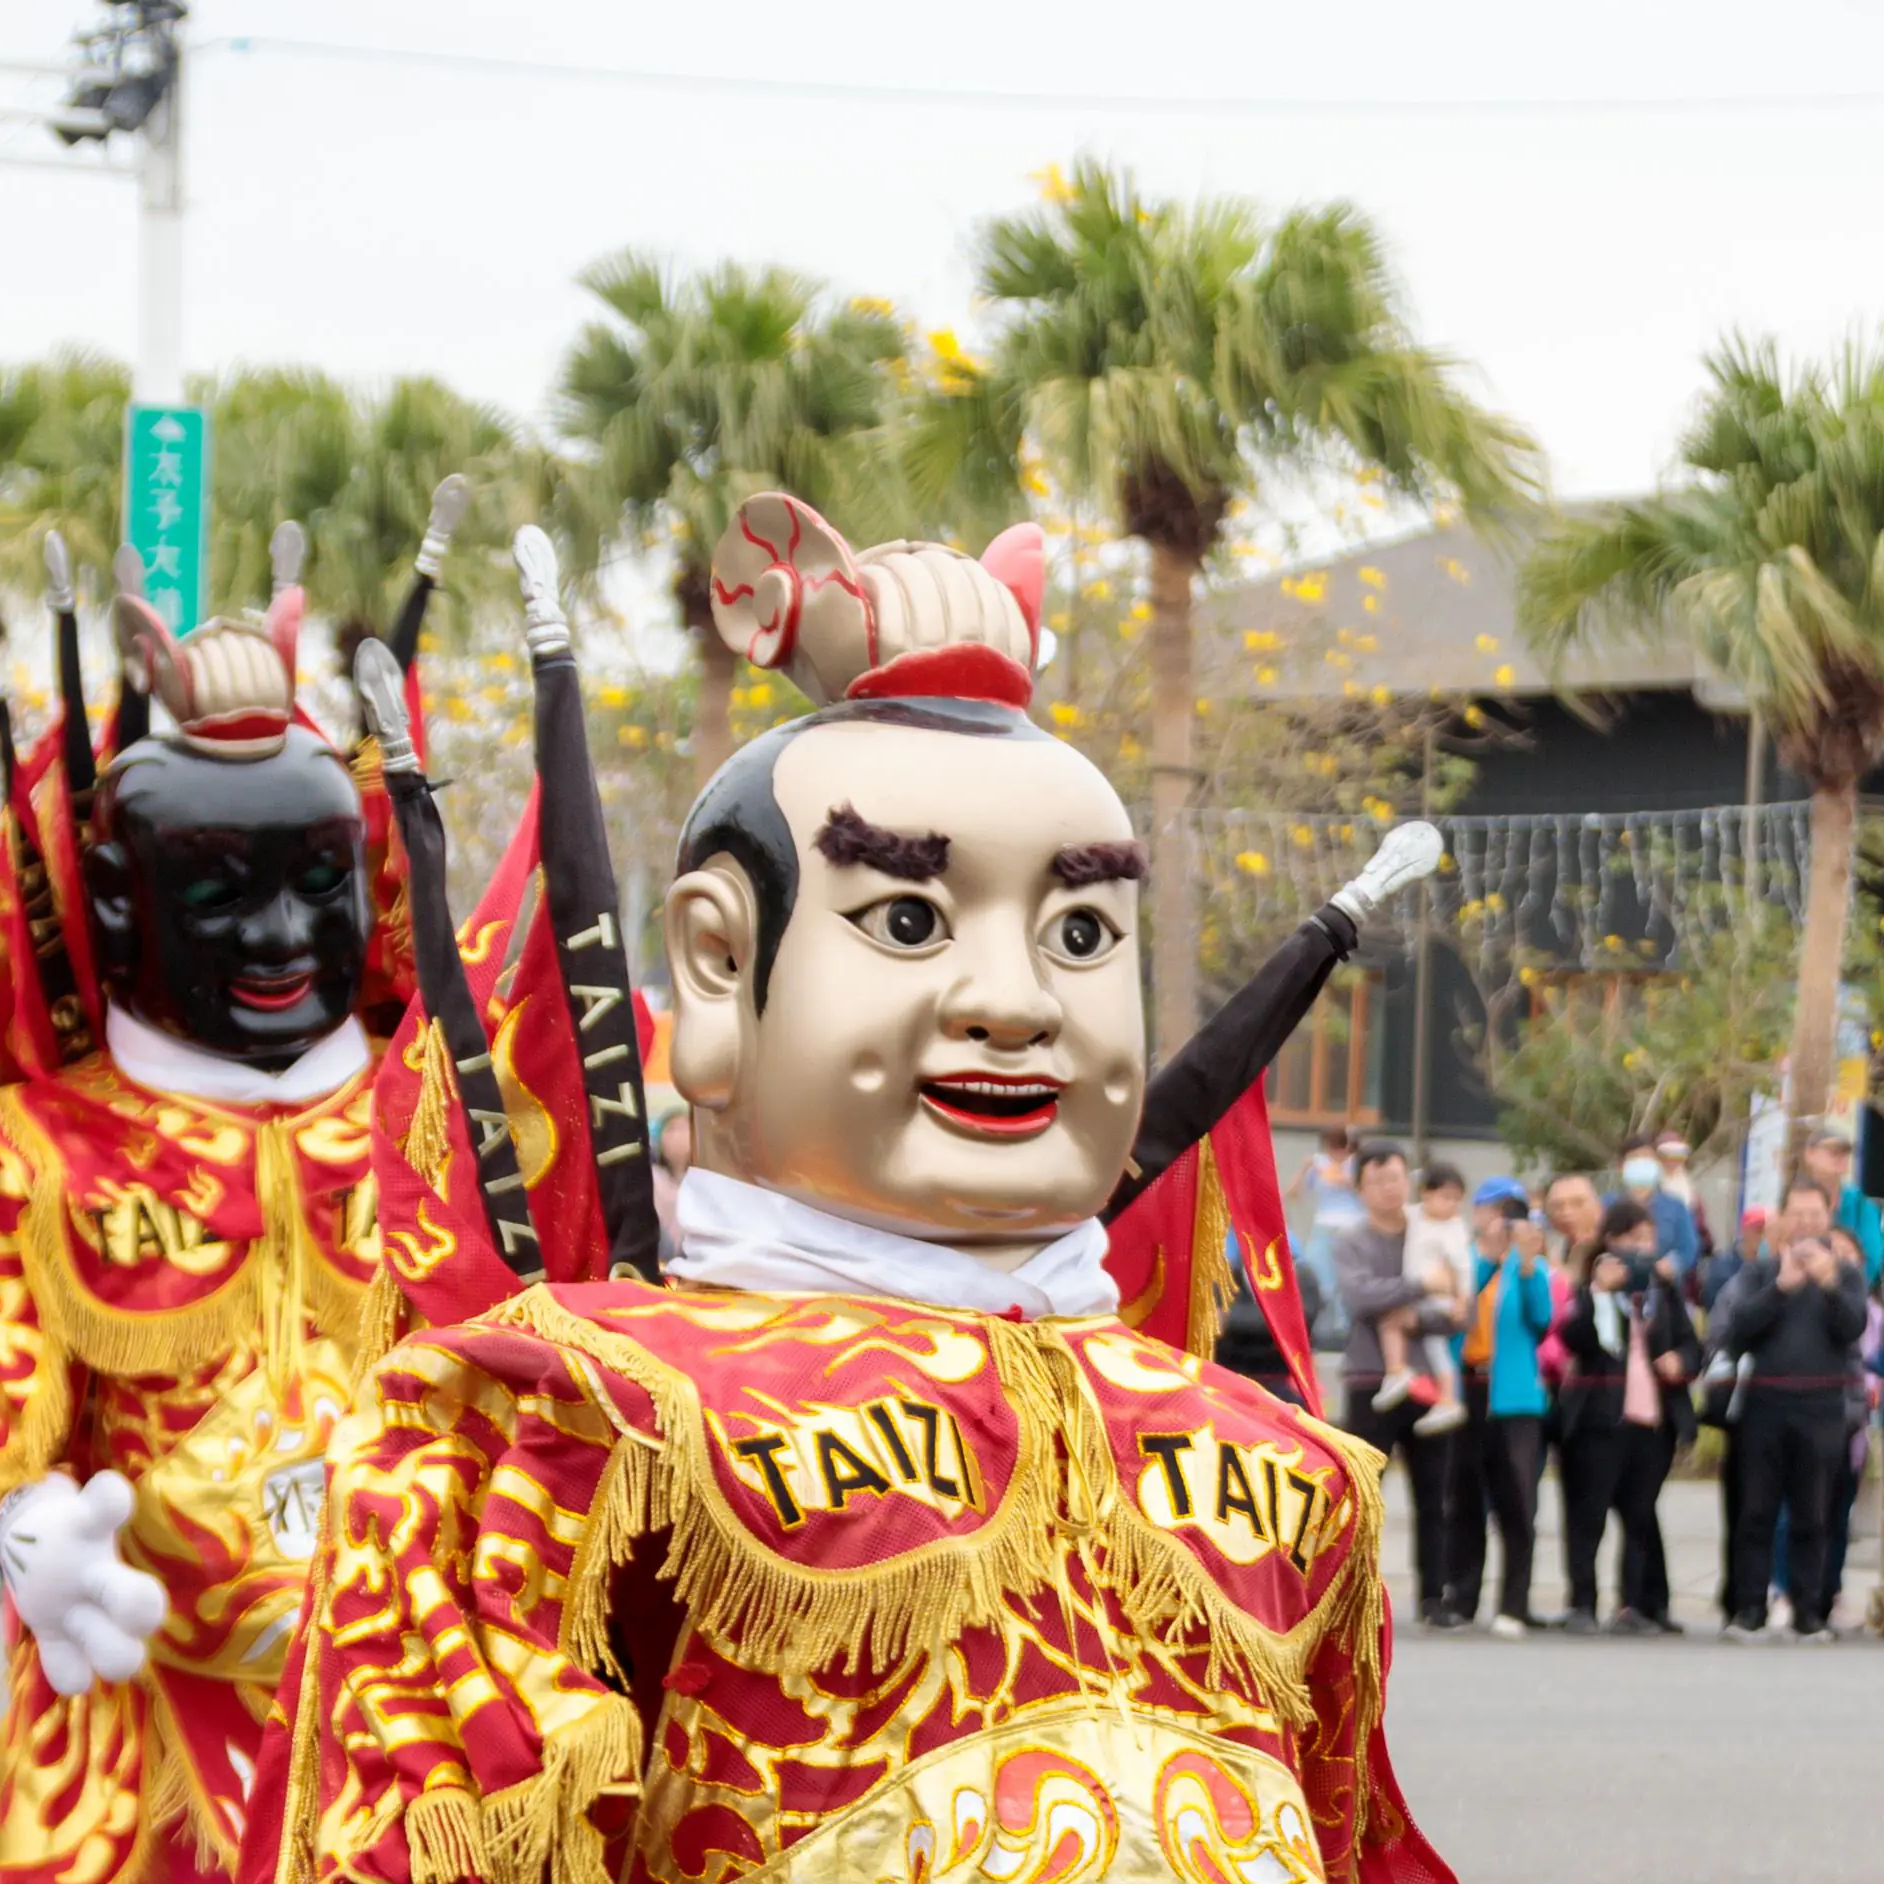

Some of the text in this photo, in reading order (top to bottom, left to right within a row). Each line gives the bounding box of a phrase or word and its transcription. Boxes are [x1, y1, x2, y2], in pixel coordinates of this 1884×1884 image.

[566, 911, 642, 1167] TAIZI
[86, 1198, 223, 1265] TAI
[735, 1400, 978, 1526] TAIZI
